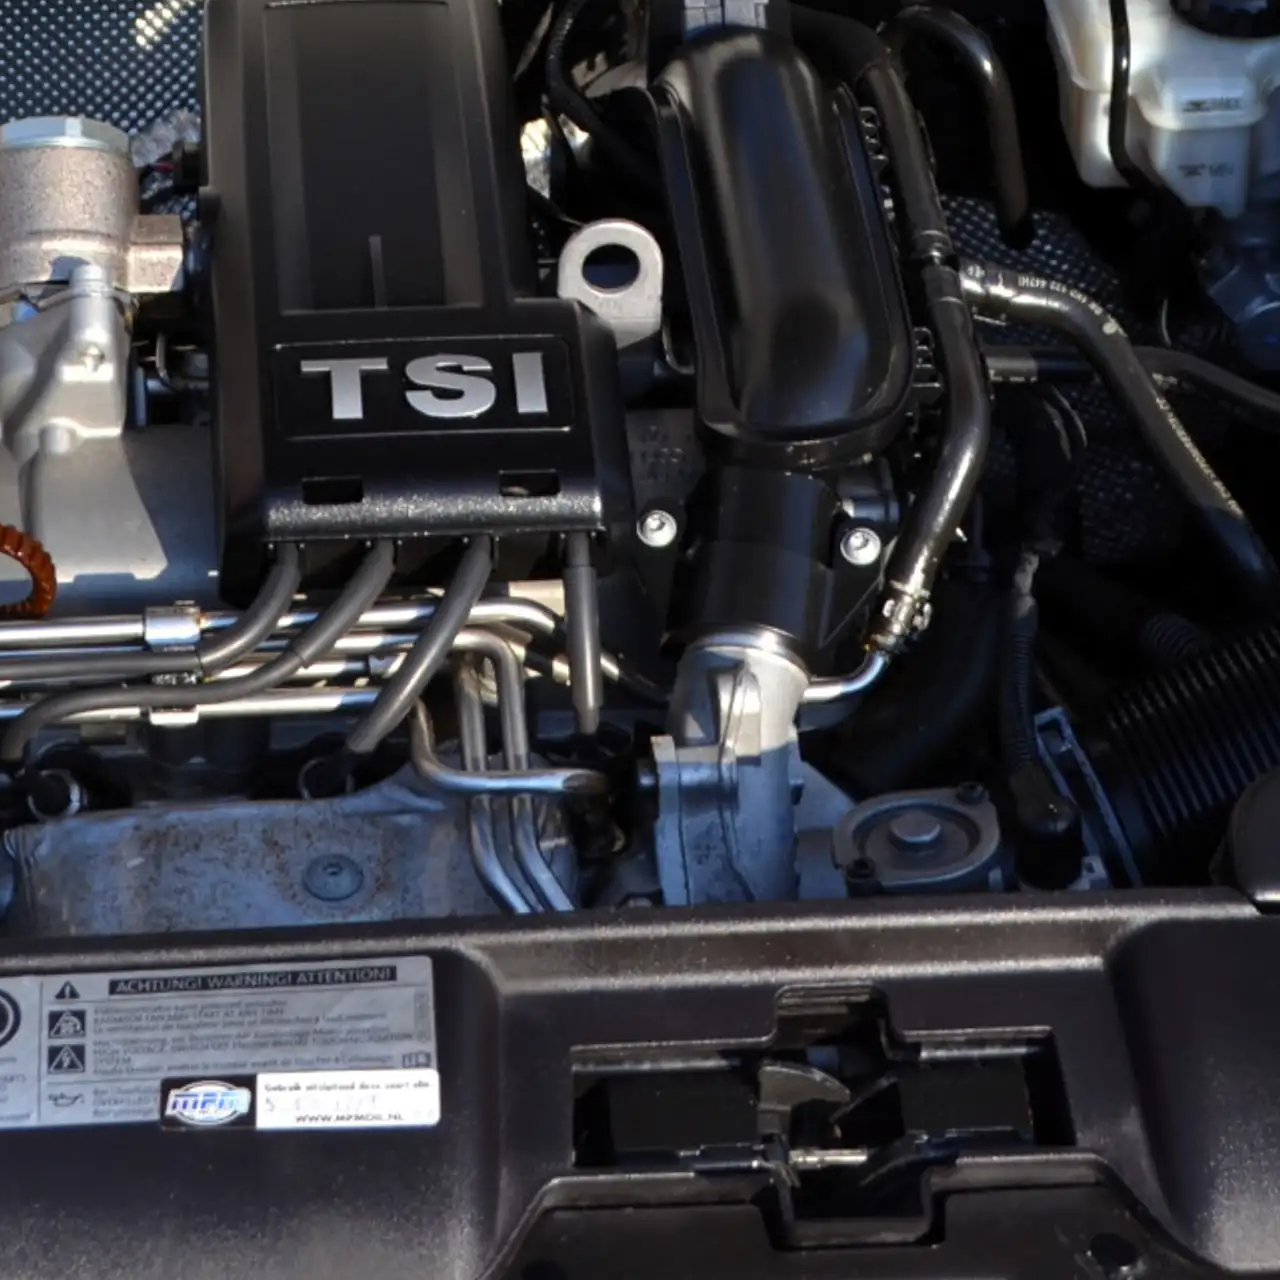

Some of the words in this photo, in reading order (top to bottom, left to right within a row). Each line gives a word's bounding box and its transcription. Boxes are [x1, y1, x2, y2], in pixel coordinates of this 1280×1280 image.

[301, 352, 548, 420] TSI
[115, 977, 202, 994] ACHTUNG!
[207, 972, 291, 989] WARNING!
[296, 967, 391, 986] ATTENTION!
